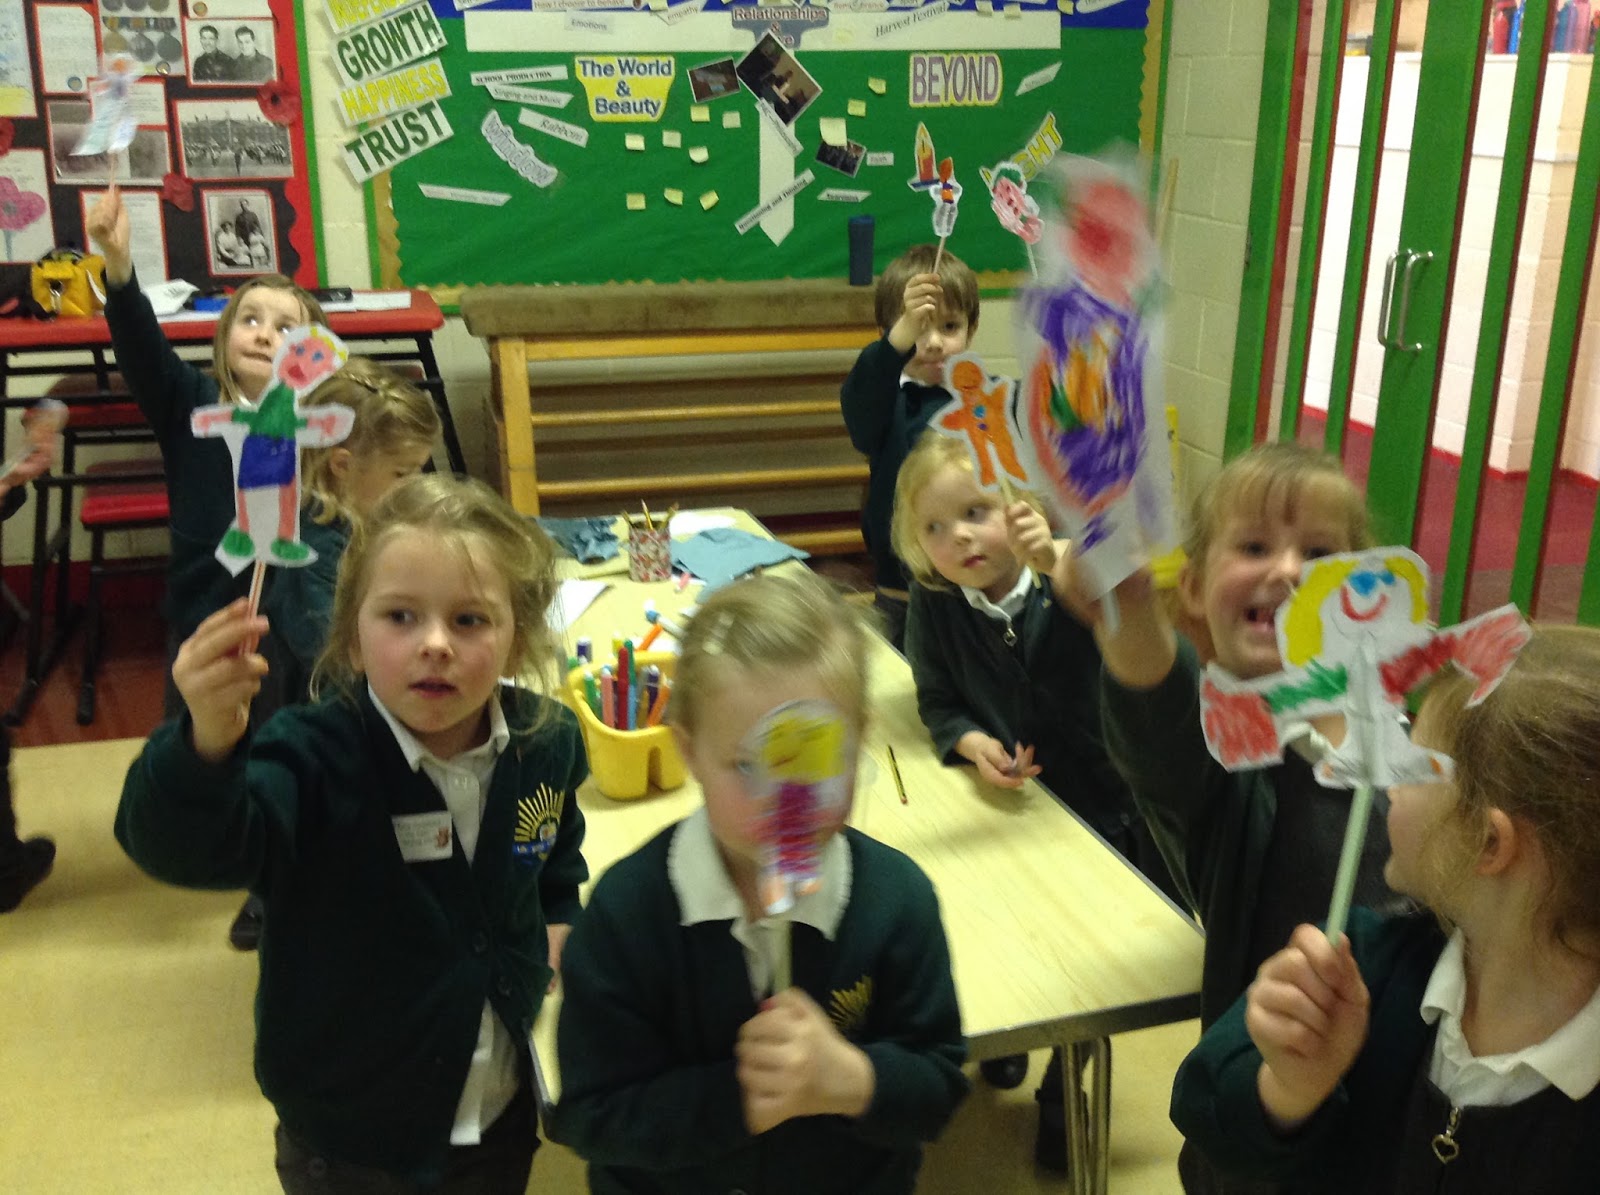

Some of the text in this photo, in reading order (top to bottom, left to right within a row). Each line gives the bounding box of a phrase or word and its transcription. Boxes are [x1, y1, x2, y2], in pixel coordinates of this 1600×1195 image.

[570, 18, 608, 31] Emotions
[734, 7, 828, 23] Relationships
[875, 2, 947, 37] Harvest Festival
[337, 4, 443, 81] GROWTH
[475, 71, 552, 84] SCHOOL PRODUCTION
[578, 58, 672, 77] The World
[615, 80, 631, 97] &
[911, 55, 1000, 104] BEYOND
[341, 63, 447, 120] HAPPINESS
[594, 97, 662, 118] Beauty
[344, 103, 444, 174] TRUST
